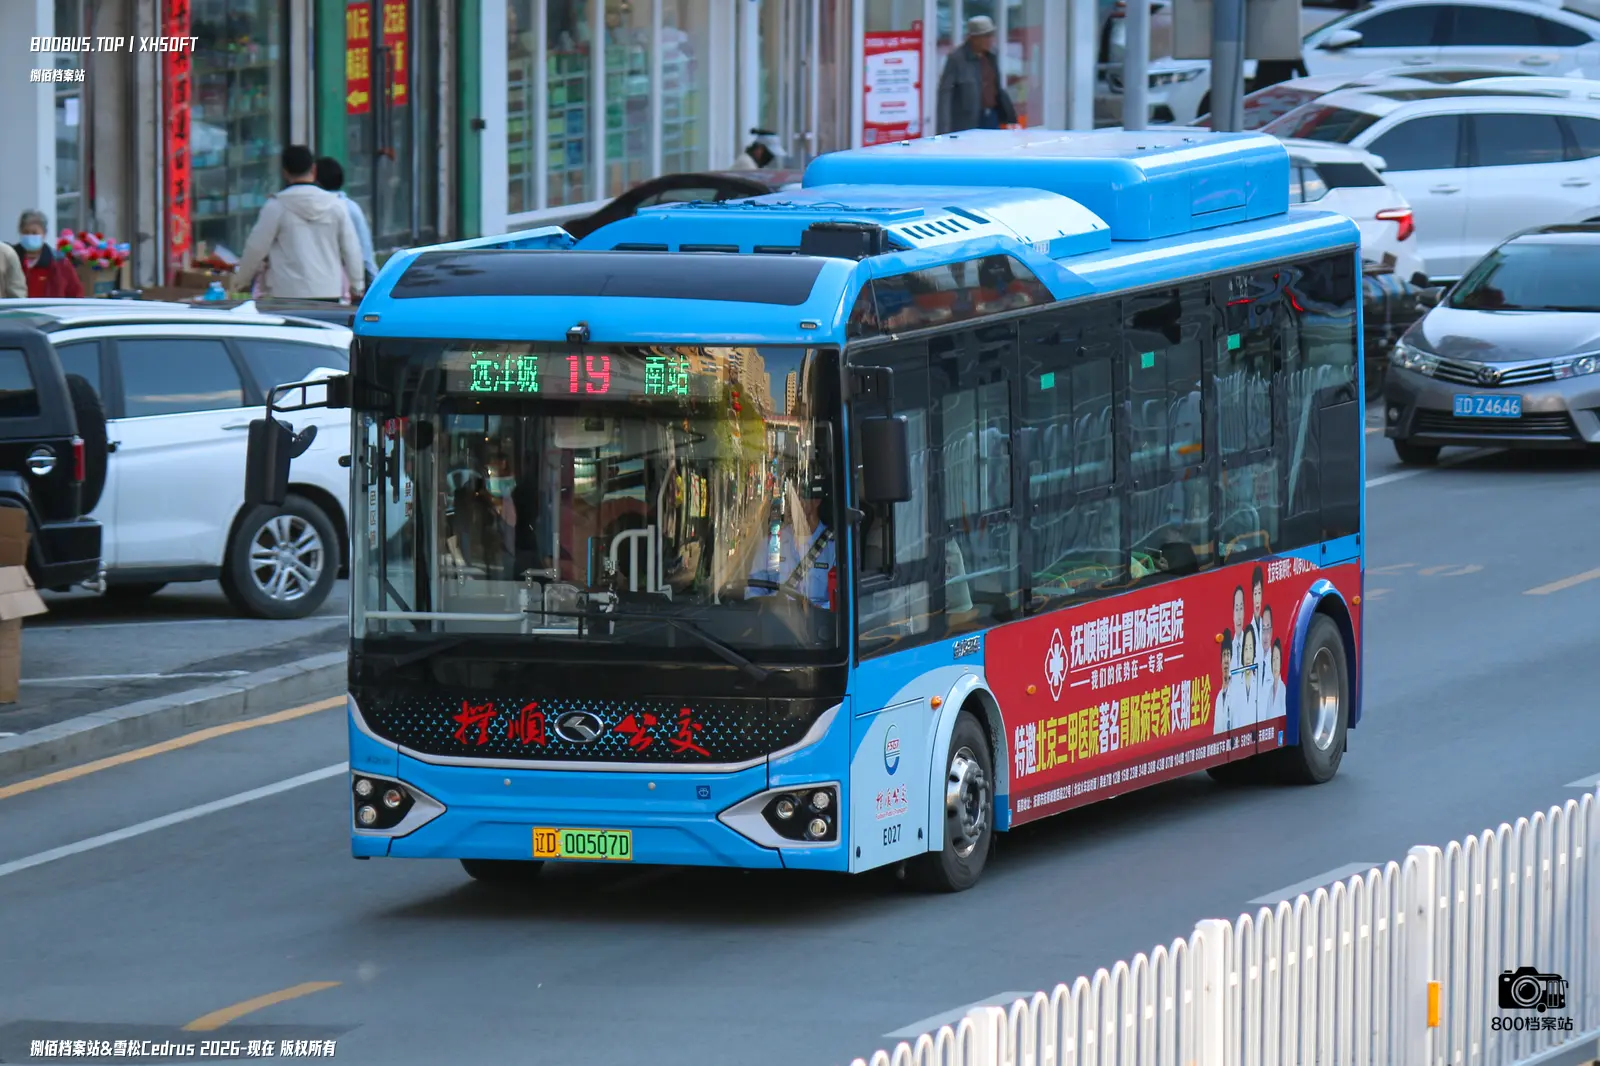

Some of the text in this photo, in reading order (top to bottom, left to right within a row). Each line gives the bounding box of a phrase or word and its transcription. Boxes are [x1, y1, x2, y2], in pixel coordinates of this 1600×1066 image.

[566, 355, 610, 393] 19
[645, 354, 690, 395] 南站
[1475, 398, 1521, 415] Z4646
[1070, 598, 1185, 668] 抚顺博仕胃肠病医院
[1014, 673, 1212, 780] 特邀北京三甲医院著名胃肠病专家长期坐诊
[536, 833, 629, 856] 辽D 00507D
[883, 824, 901, 846] E027
